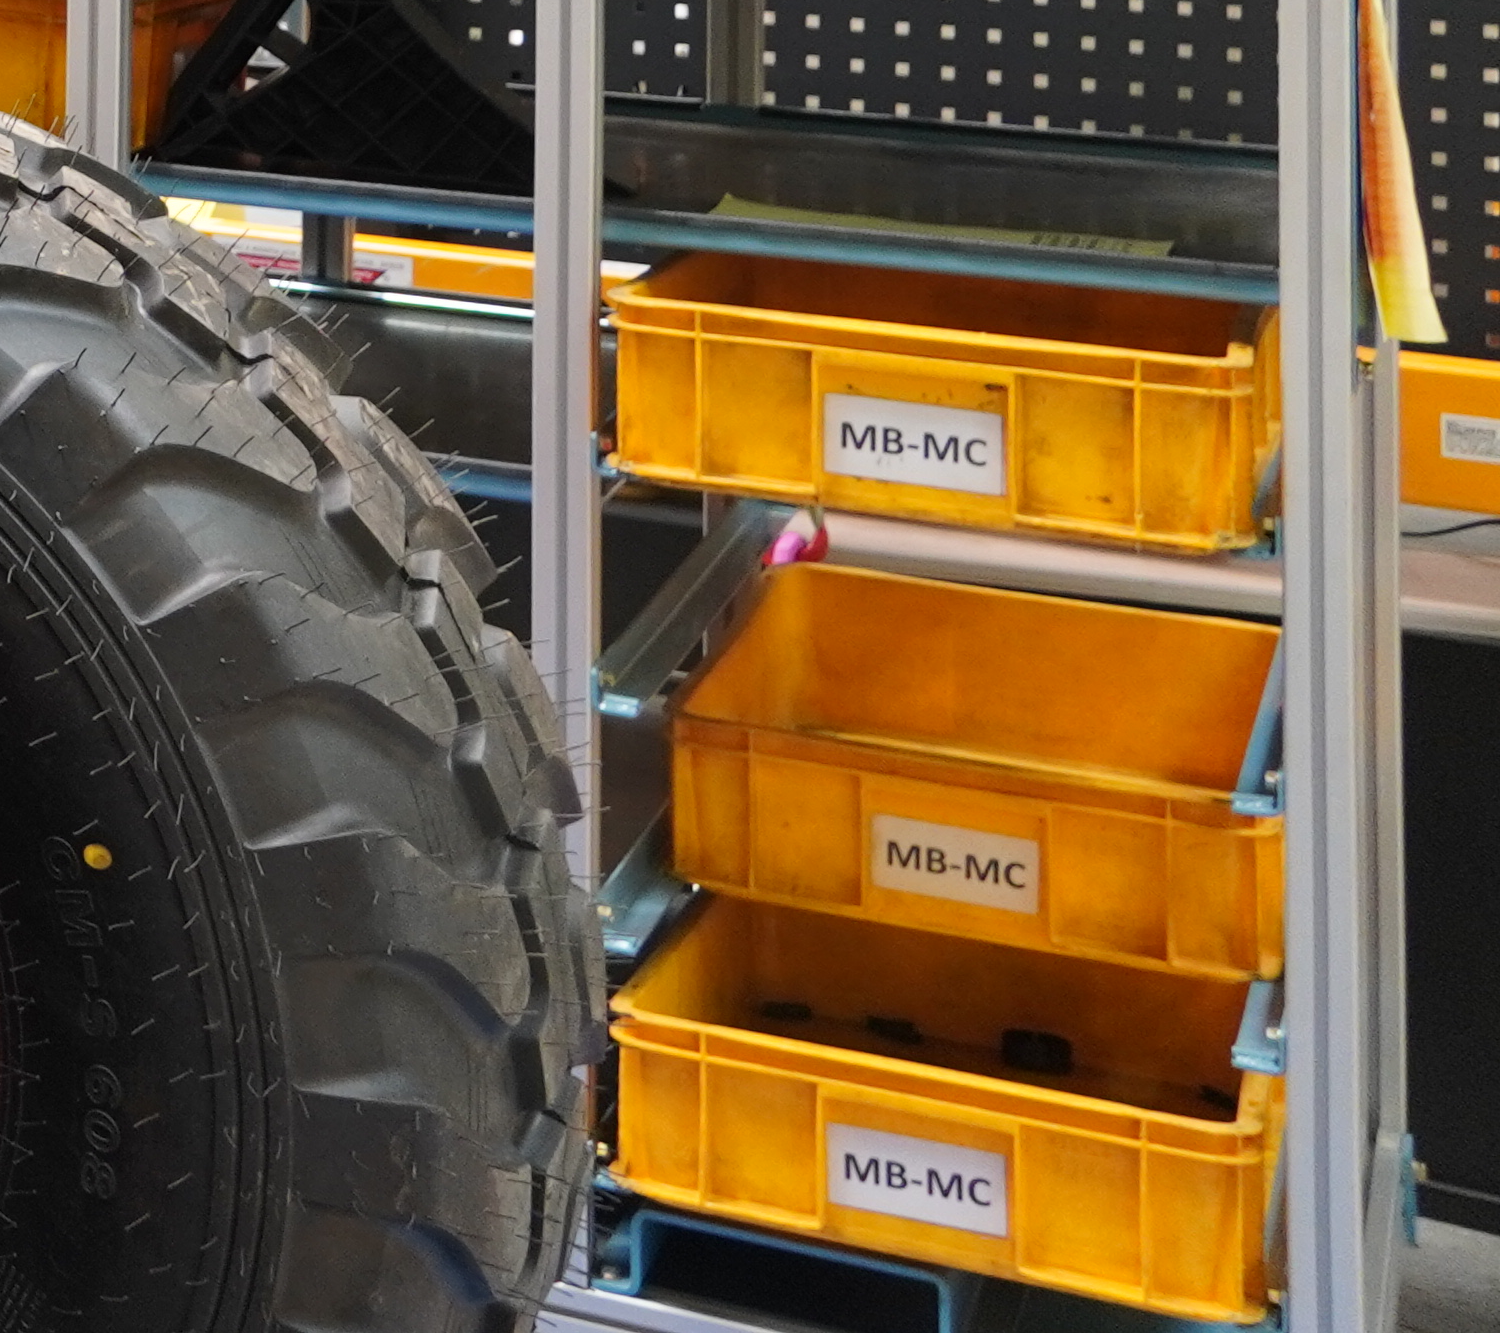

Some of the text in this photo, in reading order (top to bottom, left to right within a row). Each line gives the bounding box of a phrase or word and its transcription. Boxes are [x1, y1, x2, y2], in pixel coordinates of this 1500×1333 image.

[840, 420, 988, 467] MB-MC
[885, 839, 1028, 890] MB-MC
[79, 1064, 124, 1200] 608
[843, 1152, 992, 1207] MB-MC
